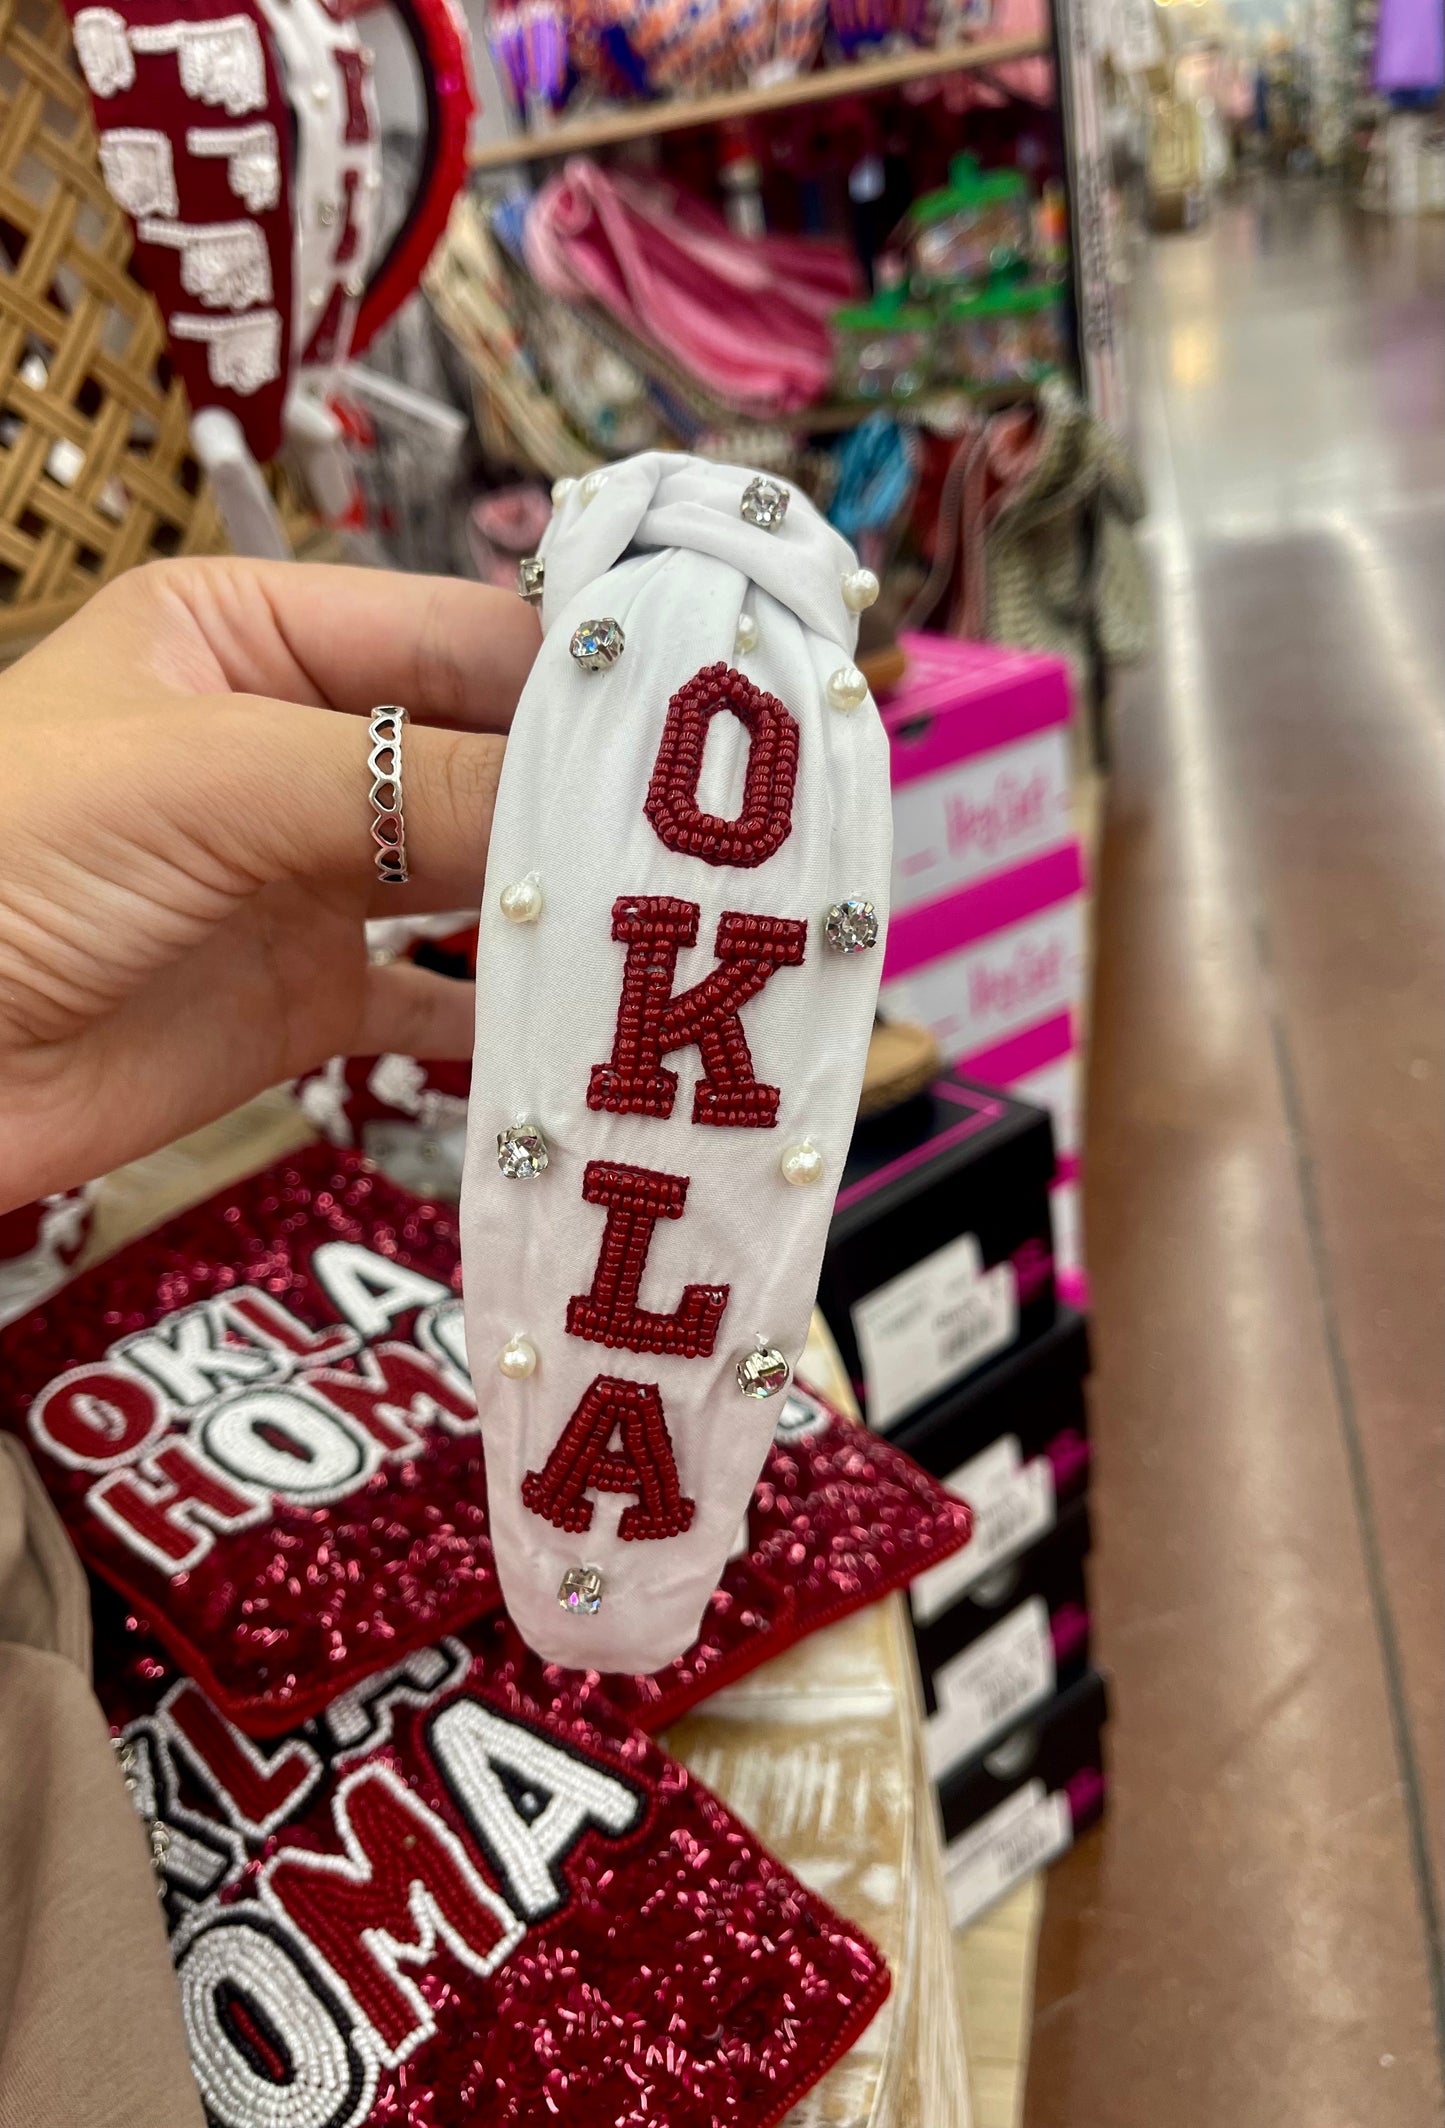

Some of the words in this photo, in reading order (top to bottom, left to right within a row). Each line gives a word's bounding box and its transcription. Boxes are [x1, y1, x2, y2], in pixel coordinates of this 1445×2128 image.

[519, 661, 806, 1545] OKLA
[28, 1239, 455, 1474] OKLA
[169, 1684, 653, 2128] OMA
